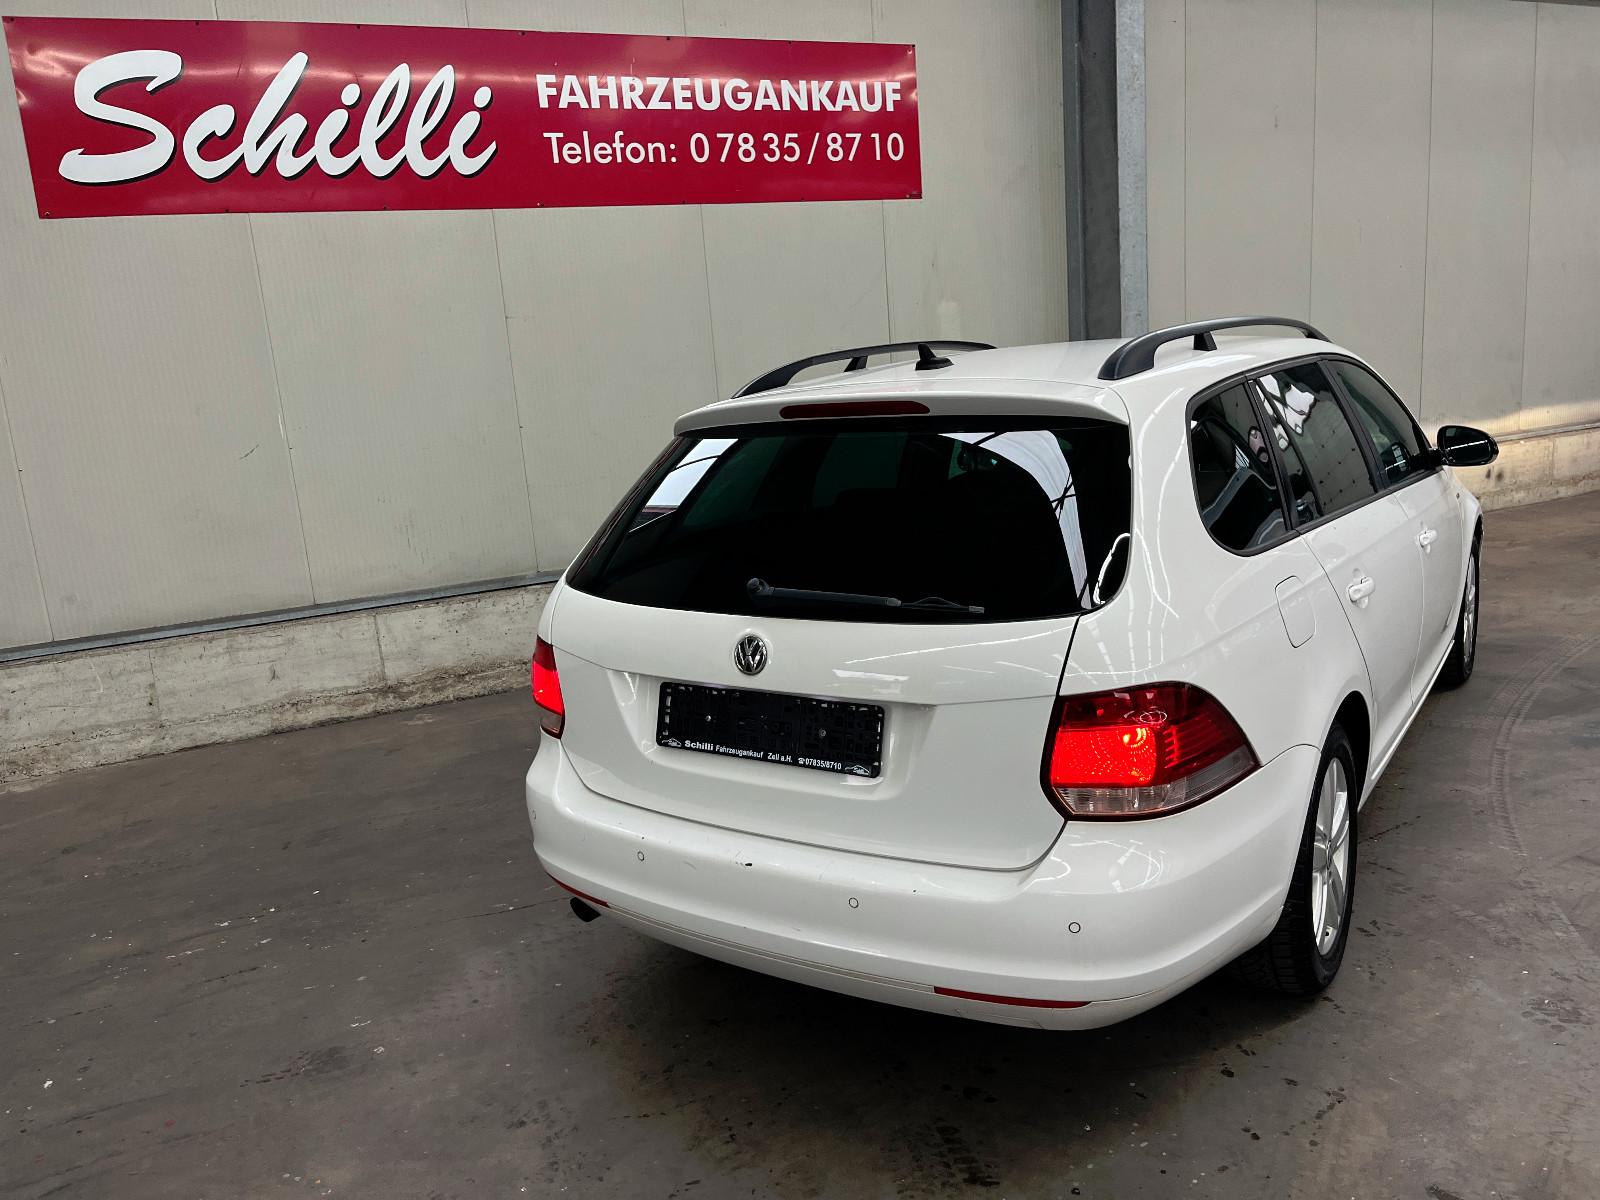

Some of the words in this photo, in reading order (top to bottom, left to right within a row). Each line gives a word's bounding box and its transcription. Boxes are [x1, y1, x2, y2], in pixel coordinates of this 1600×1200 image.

[535, 73, 902, 112] FAHRZEUGANKAUF
[58, 49, 497, 183] Schilli
[543, 130, 677, 164] Telefon:
[684, 739, 714, 751] Schilli
[715, 744, 764, 759] Fahrzeugankauf
